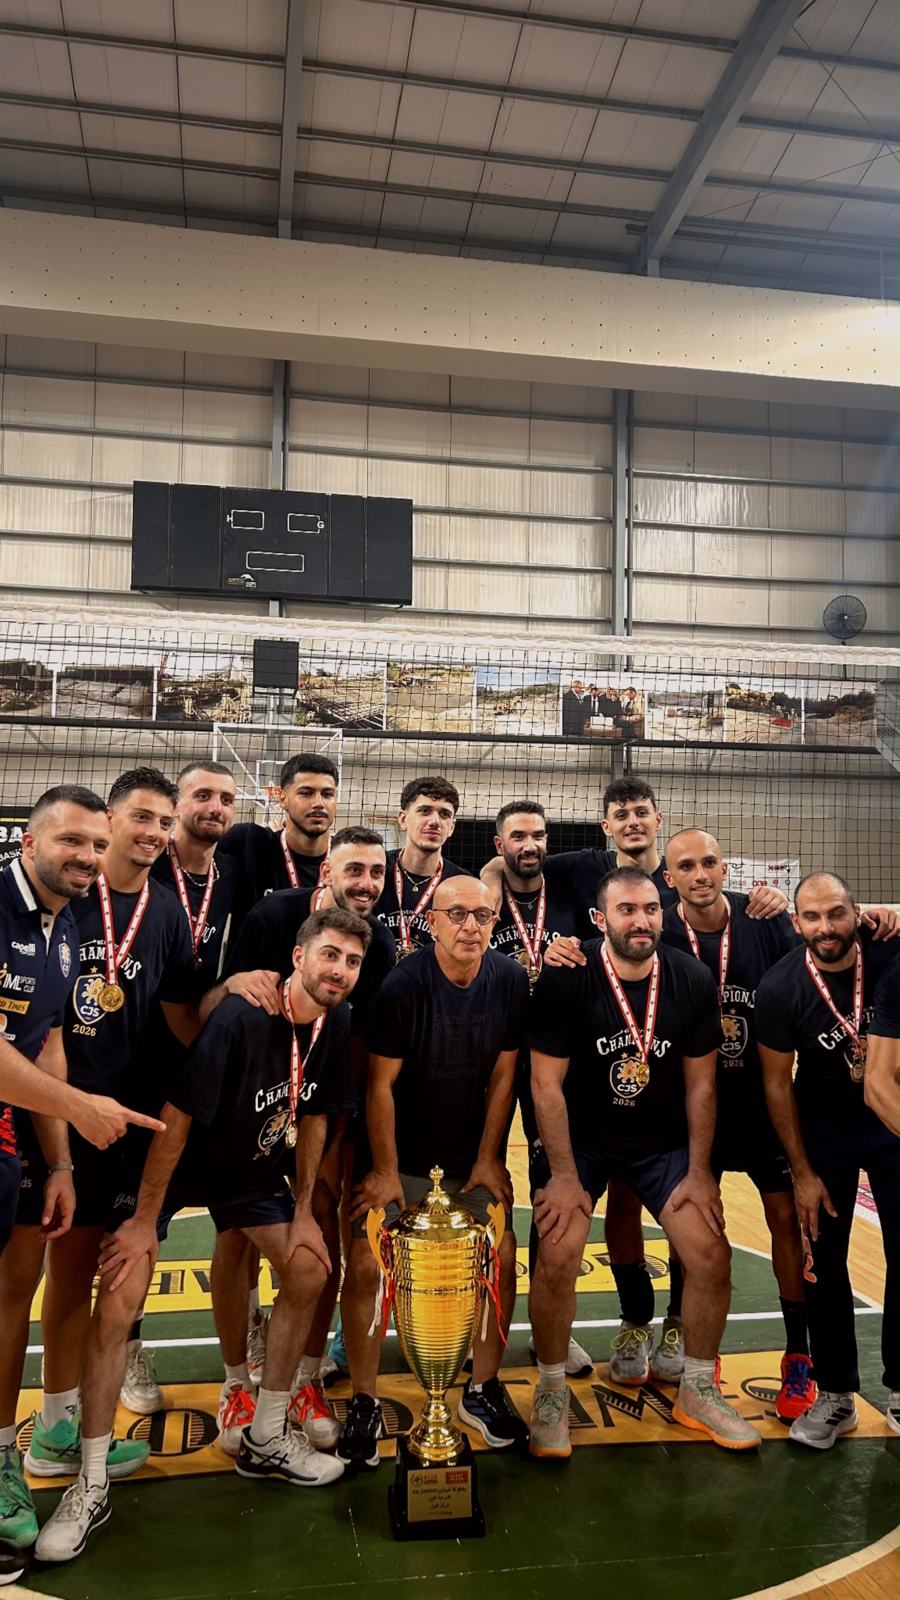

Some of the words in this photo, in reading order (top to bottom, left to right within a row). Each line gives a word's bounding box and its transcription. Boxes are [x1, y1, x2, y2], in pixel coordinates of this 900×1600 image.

[226, 514, 233, 523] H
[317, 521, 325, 529] G
[72, 1023, 97, 1037] 2026
[617, 1083, 638, 1093] CJS
[612, 1097, 636, 1107] 2026
